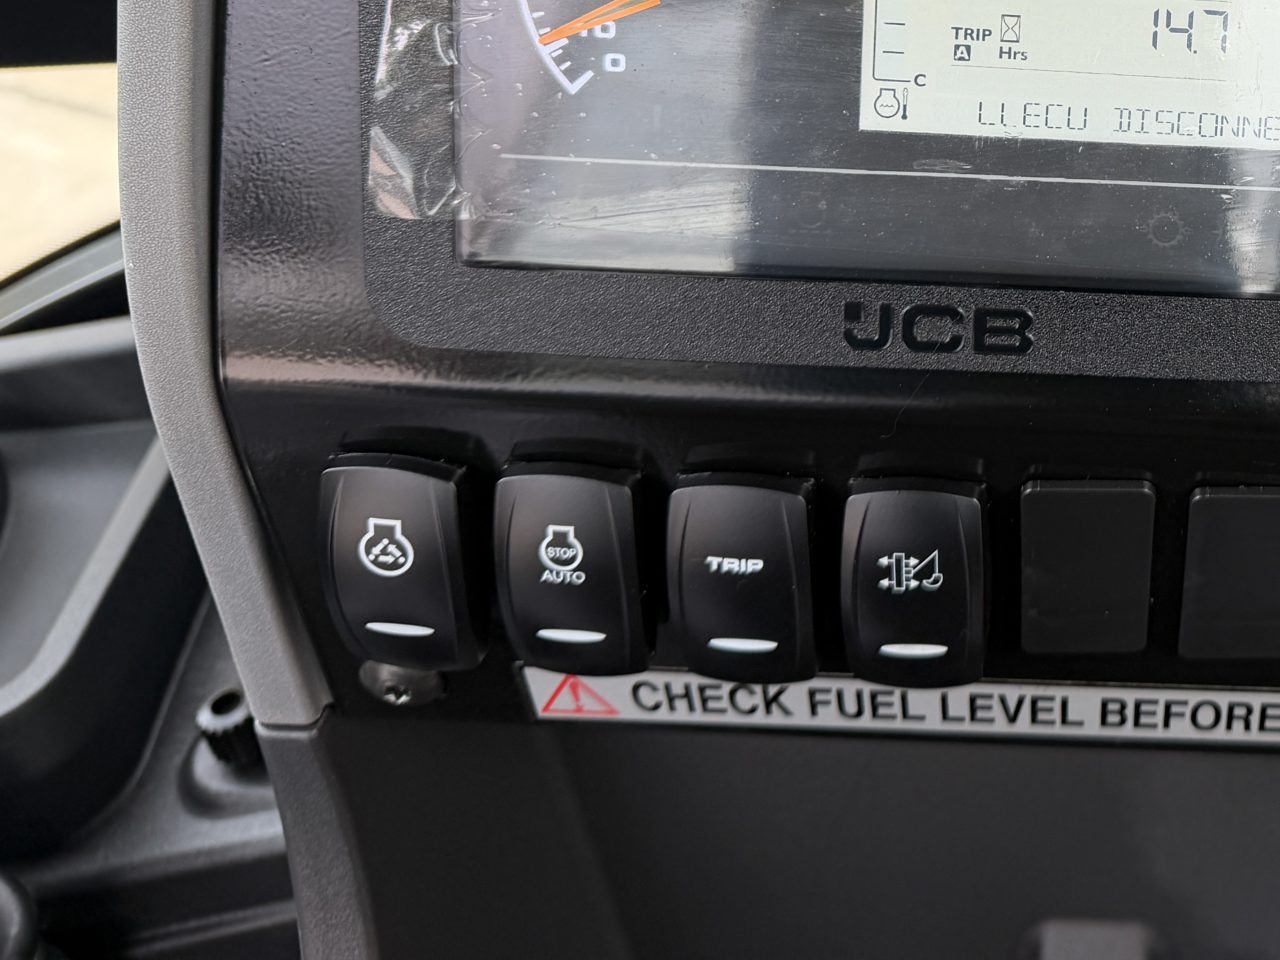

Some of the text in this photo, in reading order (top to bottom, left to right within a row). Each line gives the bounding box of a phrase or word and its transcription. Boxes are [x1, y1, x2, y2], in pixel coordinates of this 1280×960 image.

[951, 25, 993, 42] TRIP
[1150, 8, 1230, 56] 14.7
[955, 46, 970, 60] A
[998, 46, 1029, 62] Hrs
[603, 52, 627, 73] 0
[913, 73, 927, 88] C
[844, 302, 1034, 355] JCB
[546, 546, 577, 560] STOP
[704, 555, 765, 575] TRIP
[540, 570, 587, 586] AUTO
[631, 679, 794, 717] CHECK
[807, 686, 927, 722] FUEL
[939, 691, 1086, 727] LEVEL
